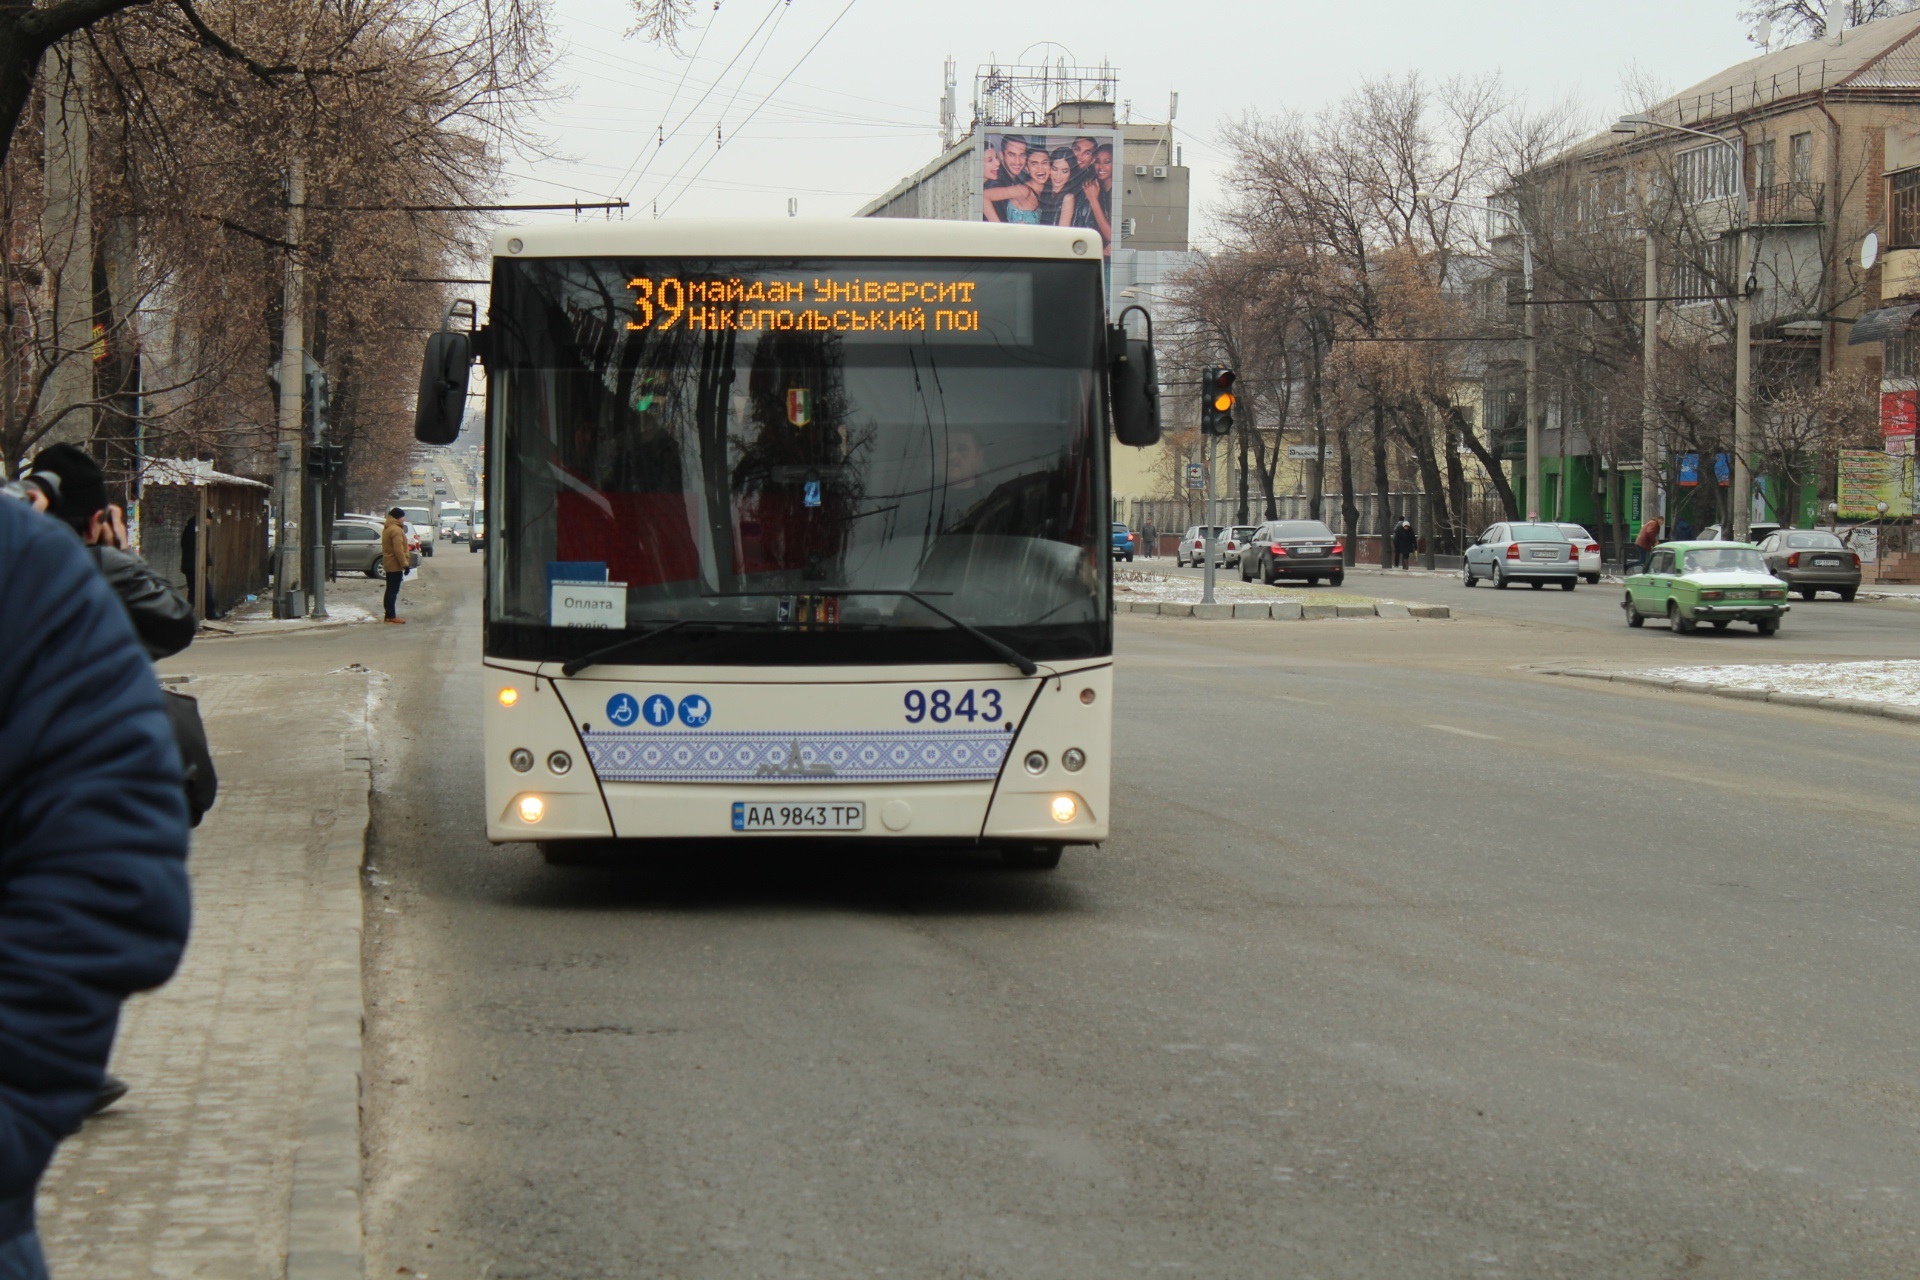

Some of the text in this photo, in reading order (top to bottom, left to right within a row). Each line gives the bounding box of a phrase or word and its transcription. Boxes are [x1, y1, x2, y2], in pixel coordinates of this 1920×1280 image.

[688, 278, 804, 302] майдан
[626, 277, 685, 331] 39
[688, 306, 926, 331] Нікопольський
[564, 597, 613, 609] Оплата
[903, 688, 1003, 723] 9843
[779, 806, 827, 826] 9843
